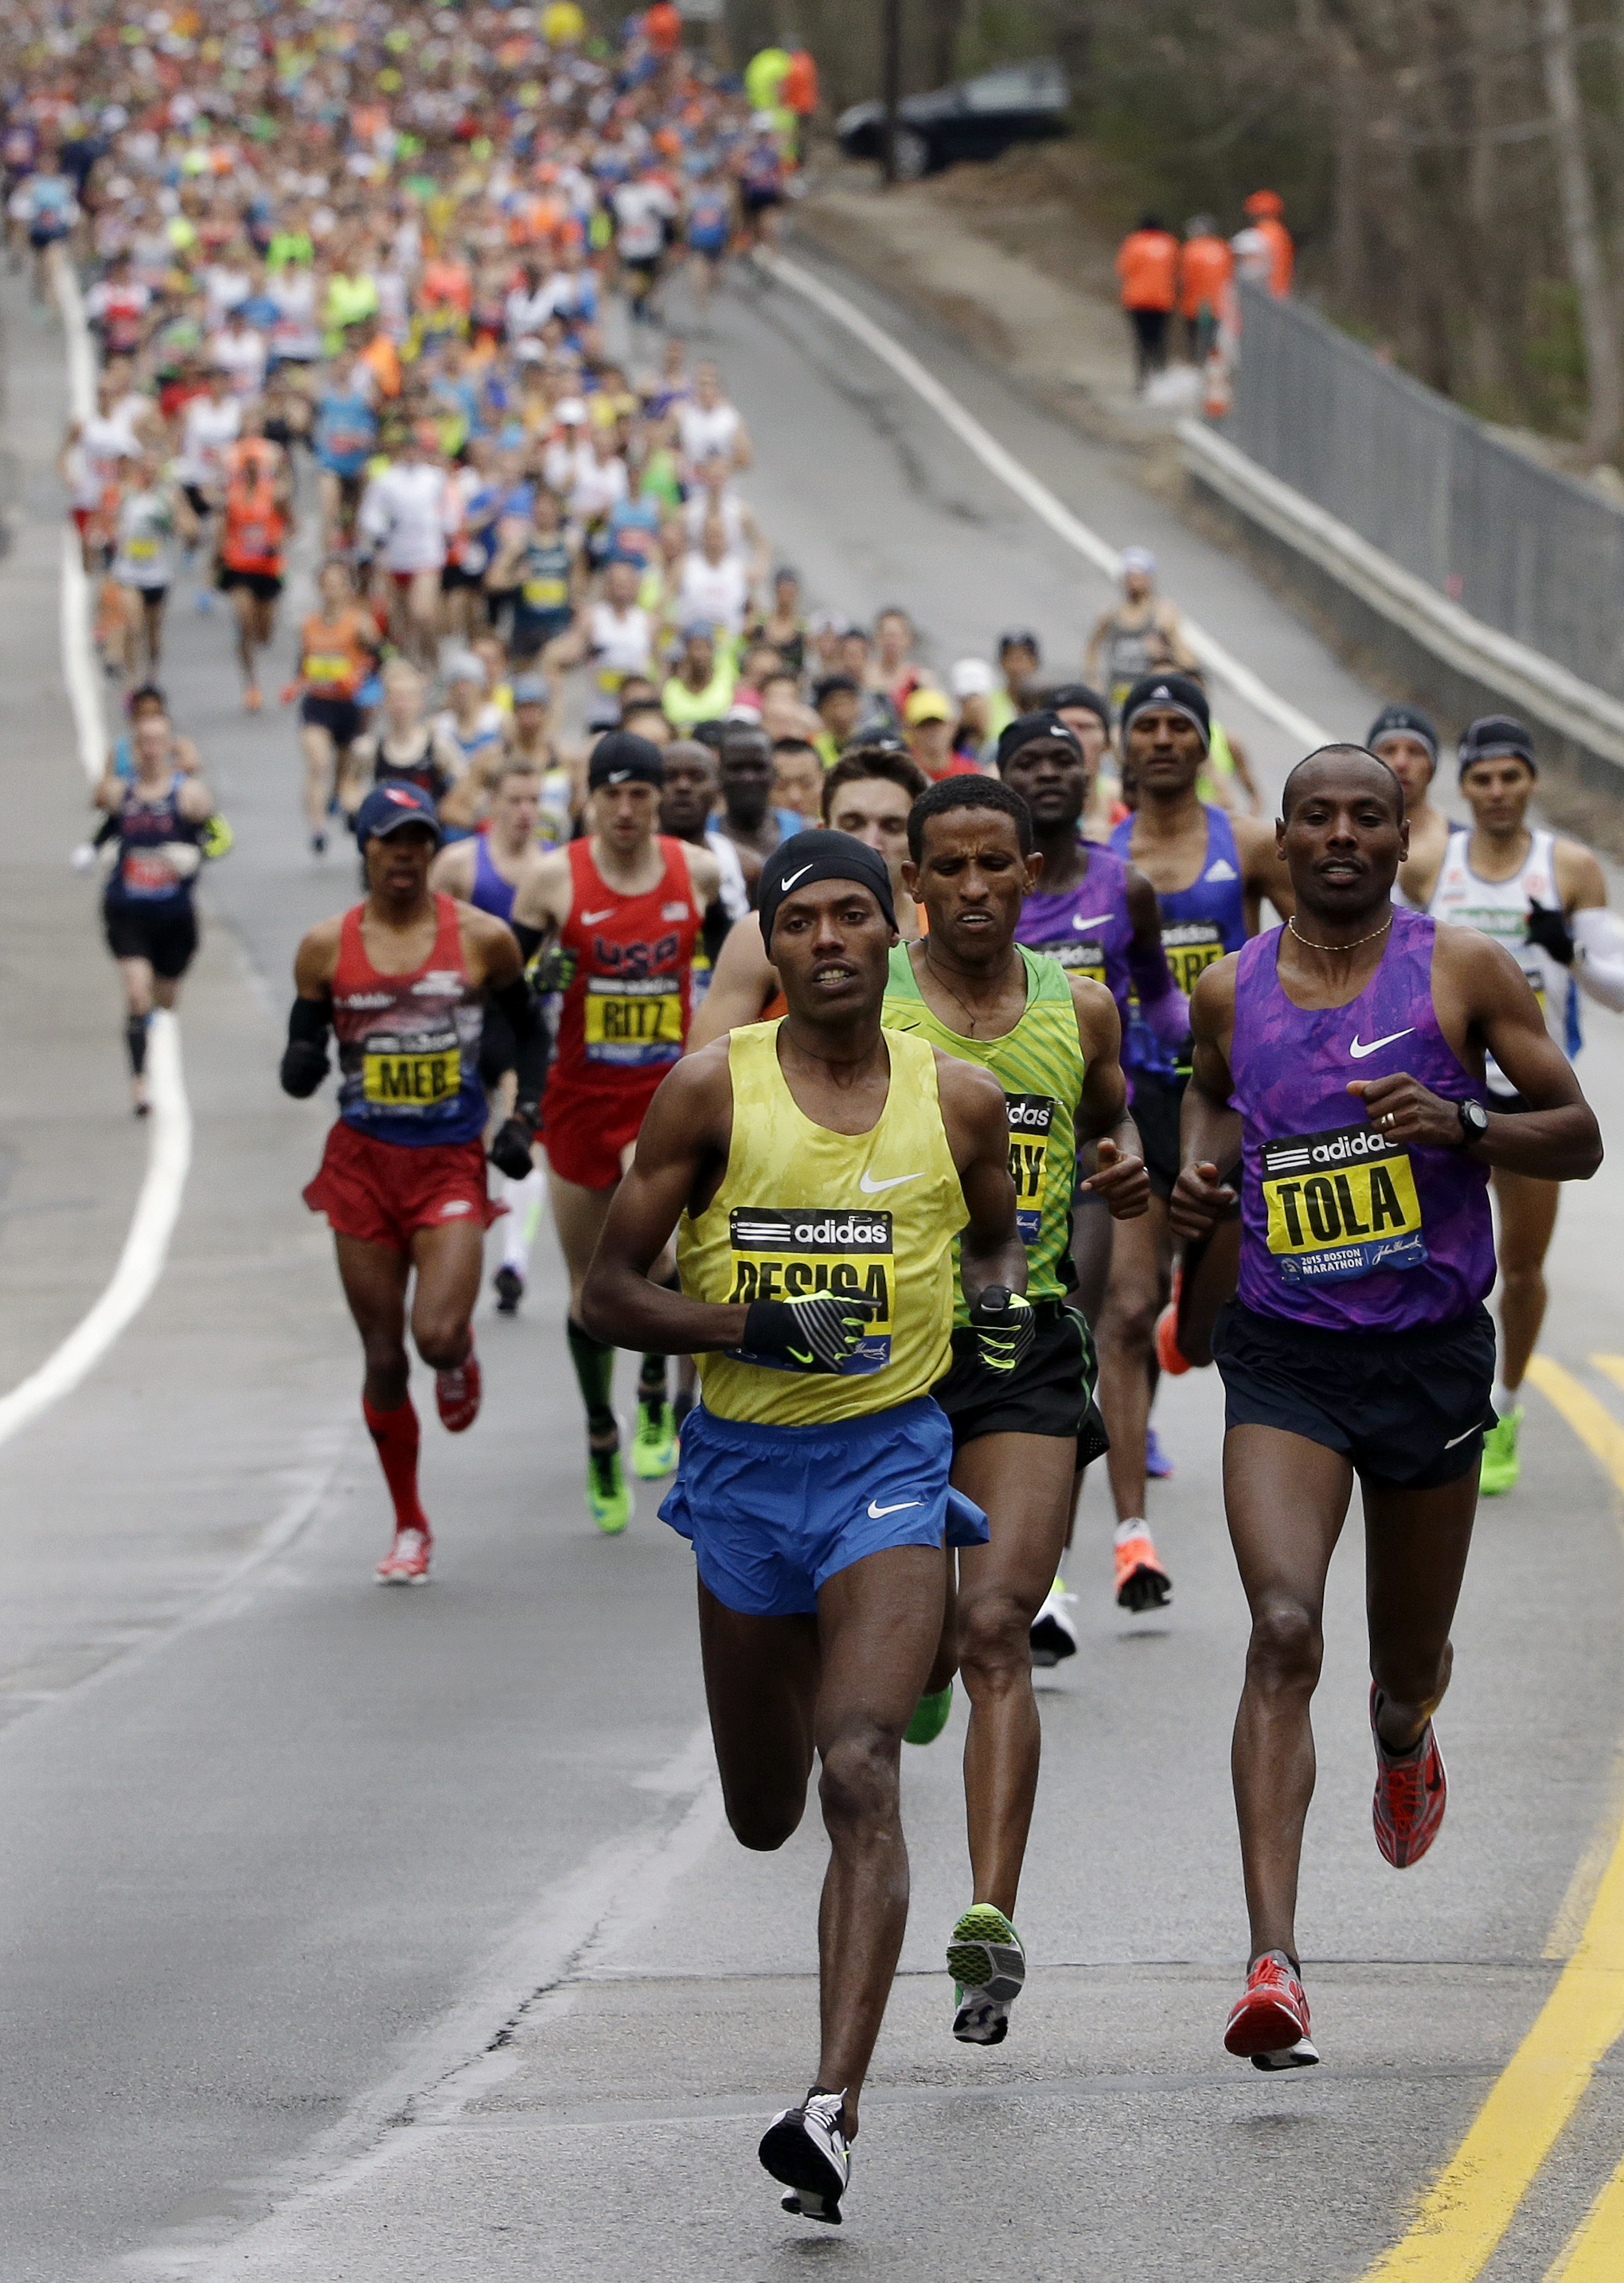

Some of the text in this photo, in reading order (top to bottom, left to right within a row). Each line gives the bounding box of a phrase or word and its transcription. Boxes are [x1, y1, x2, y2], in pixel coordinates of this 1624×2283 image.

[593, 932, 680, 974] USA
[604, 1001, 665, 1037] RITZ
[380, 1060, 447, 1098] MEB
[1312, 1131, 1399, 1162] adida
[1276, 1166, 1407, 1247] TOLA
[794, 1220, 888, 1243] adidas
[1301, 1248, 1361, 1266] 2015 BOSTON
[1302, 1257, 1364, 1274] MARATHON
